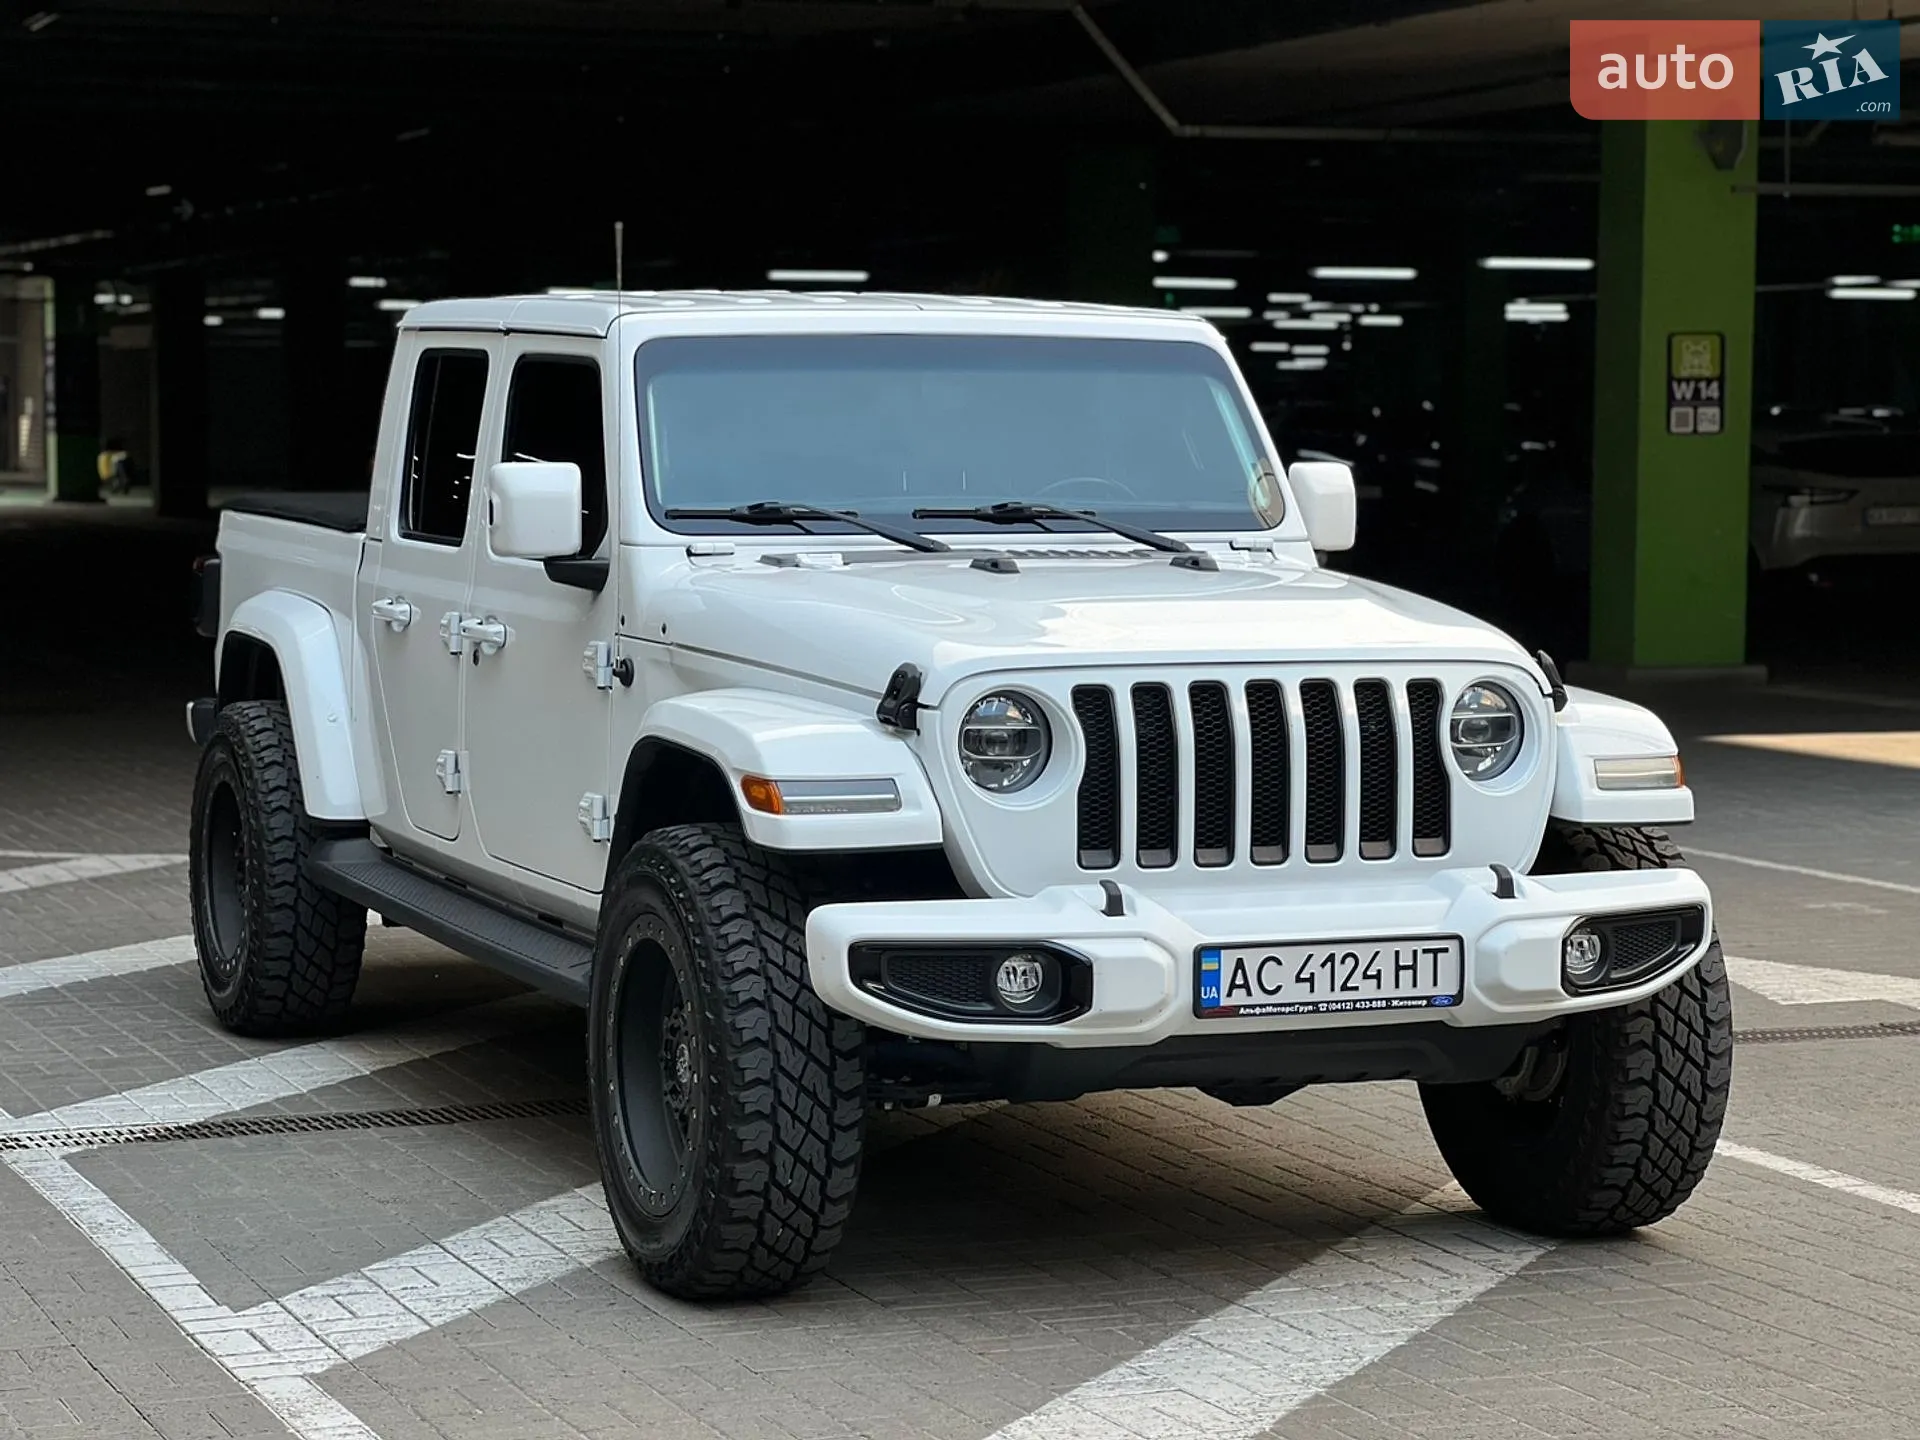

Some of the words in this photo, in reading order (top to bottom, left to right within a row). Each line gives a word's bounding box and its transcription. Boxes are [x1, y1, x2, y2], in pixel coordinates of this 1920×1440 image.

[1226, 955, 1284, 998] AC
[1294, 950, 1383, 994] 4124
[1394, 947, 1449, 989] HT
[1201, 986, 1218, 999] UA
